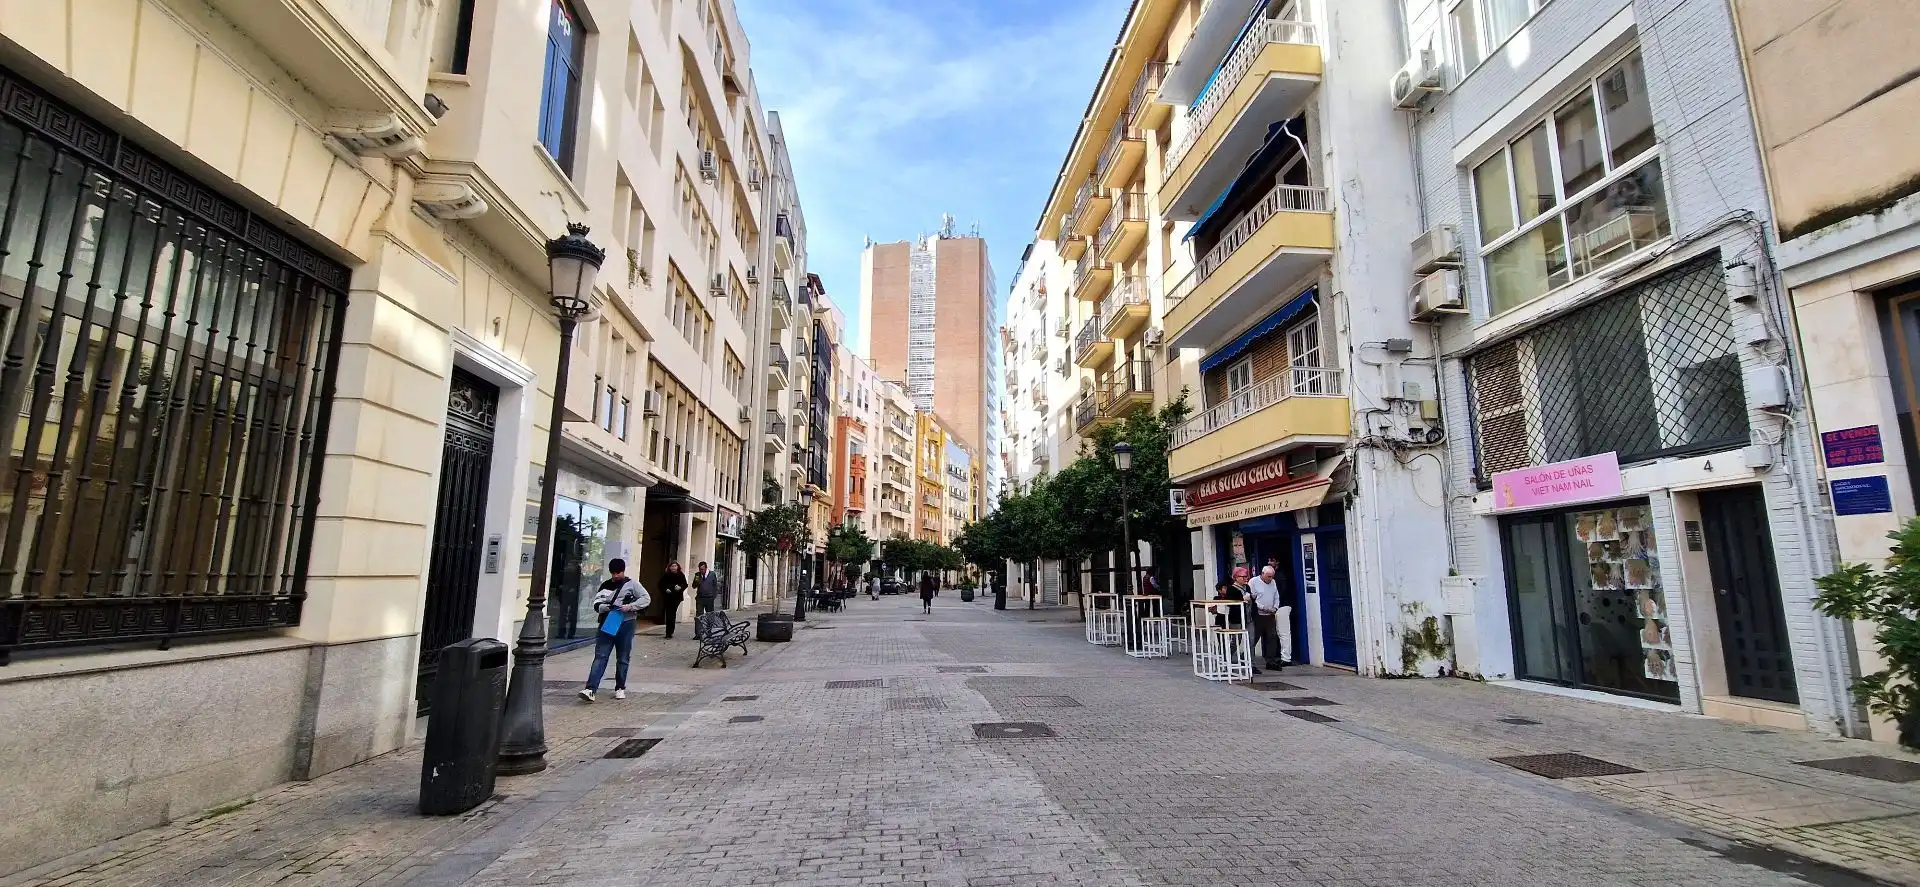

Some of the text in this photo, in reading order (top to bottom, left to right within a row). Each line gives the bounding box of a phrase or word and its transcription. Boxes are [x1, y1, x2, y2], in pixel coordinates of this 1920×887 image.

[1827, 427, 1879, 442] SE VENDE
[1704, 459, 1713, 472] 4
[1200, 460, 1283, 498] BAR SUIZO CHICO
[1525, 464, 1594, 485] SALÓN DE UÑAS
[1532, 479, 1595, 496] VIET NAM NAIL
[1244, 504, 1271, 515] PRIMITIVA
[1284, 499, 1289, 507] 2
